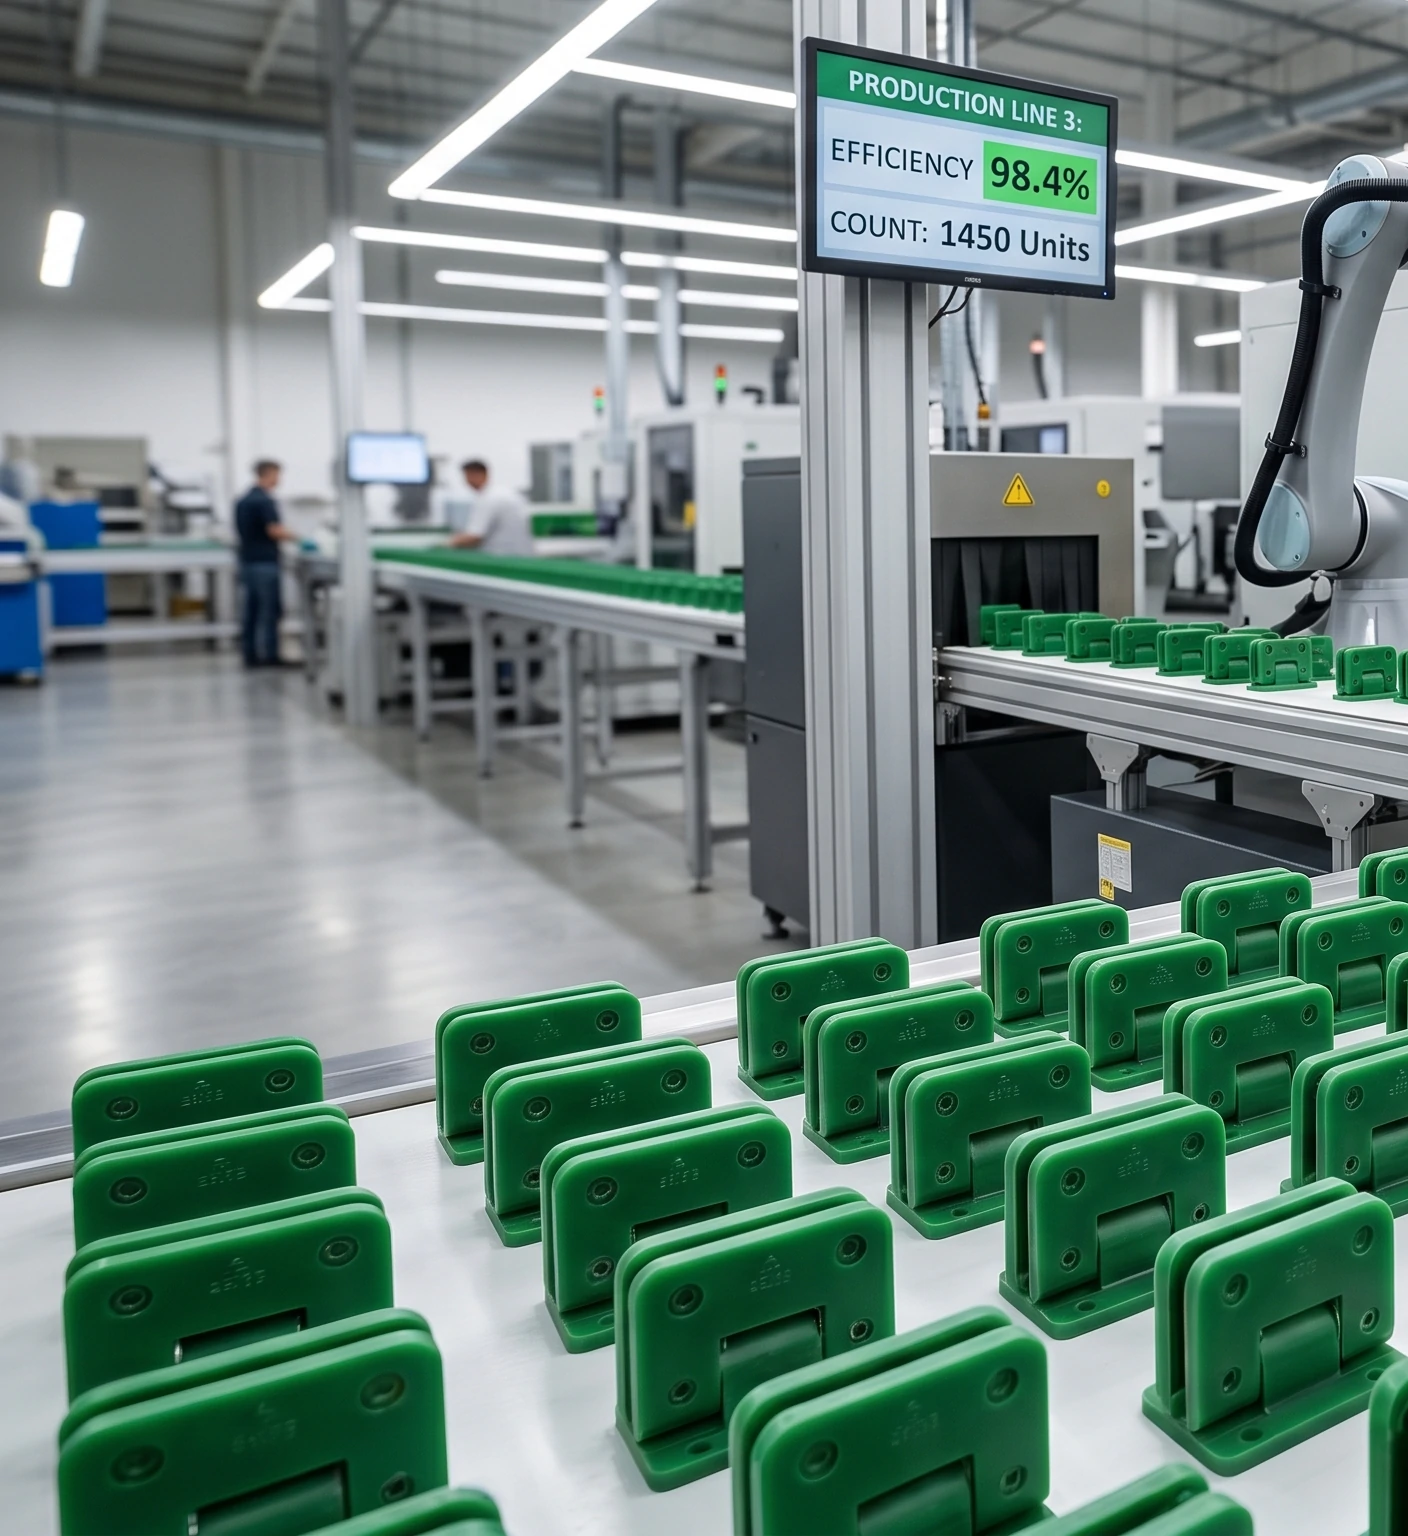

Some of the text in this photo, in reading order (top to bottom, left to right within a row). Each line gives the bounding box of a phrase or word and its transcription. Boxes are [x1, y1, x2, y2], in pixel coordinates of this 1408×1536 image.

[849, 70, 1082, 133] PRODUCTION LINE 3:
[831, 138, 1090, 201] EFFICIENCY 98.4%
[830, 210, 1090, 262] COUNT: 1450 Units
